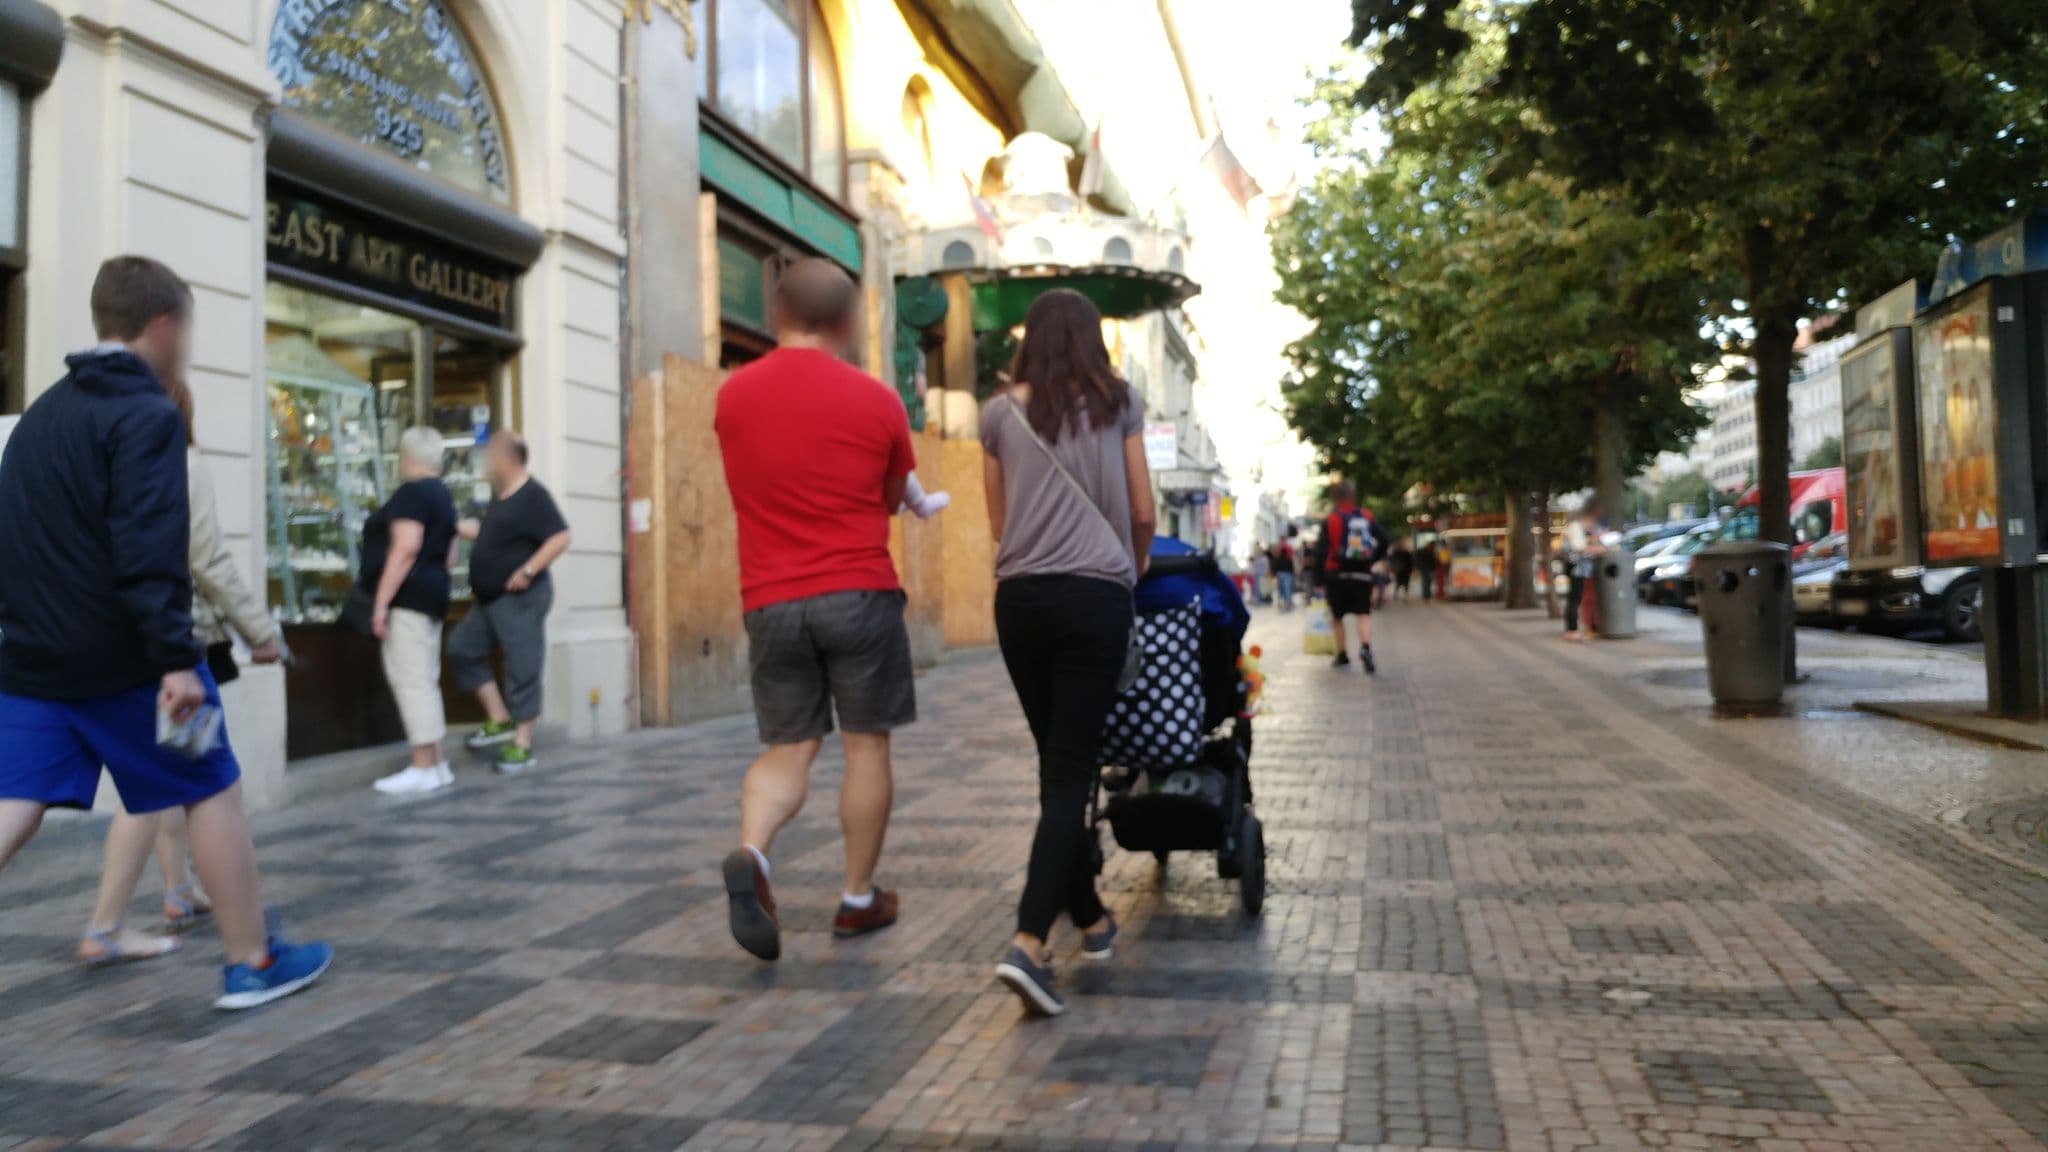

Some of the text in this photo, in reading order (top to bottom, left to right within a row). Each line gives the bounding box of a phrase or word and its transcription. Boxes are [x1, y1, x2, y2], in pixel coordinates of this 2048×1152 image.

[375, 105, 424, 153] 925
[266, 201, 510, 316] EAST ART GALLERY
